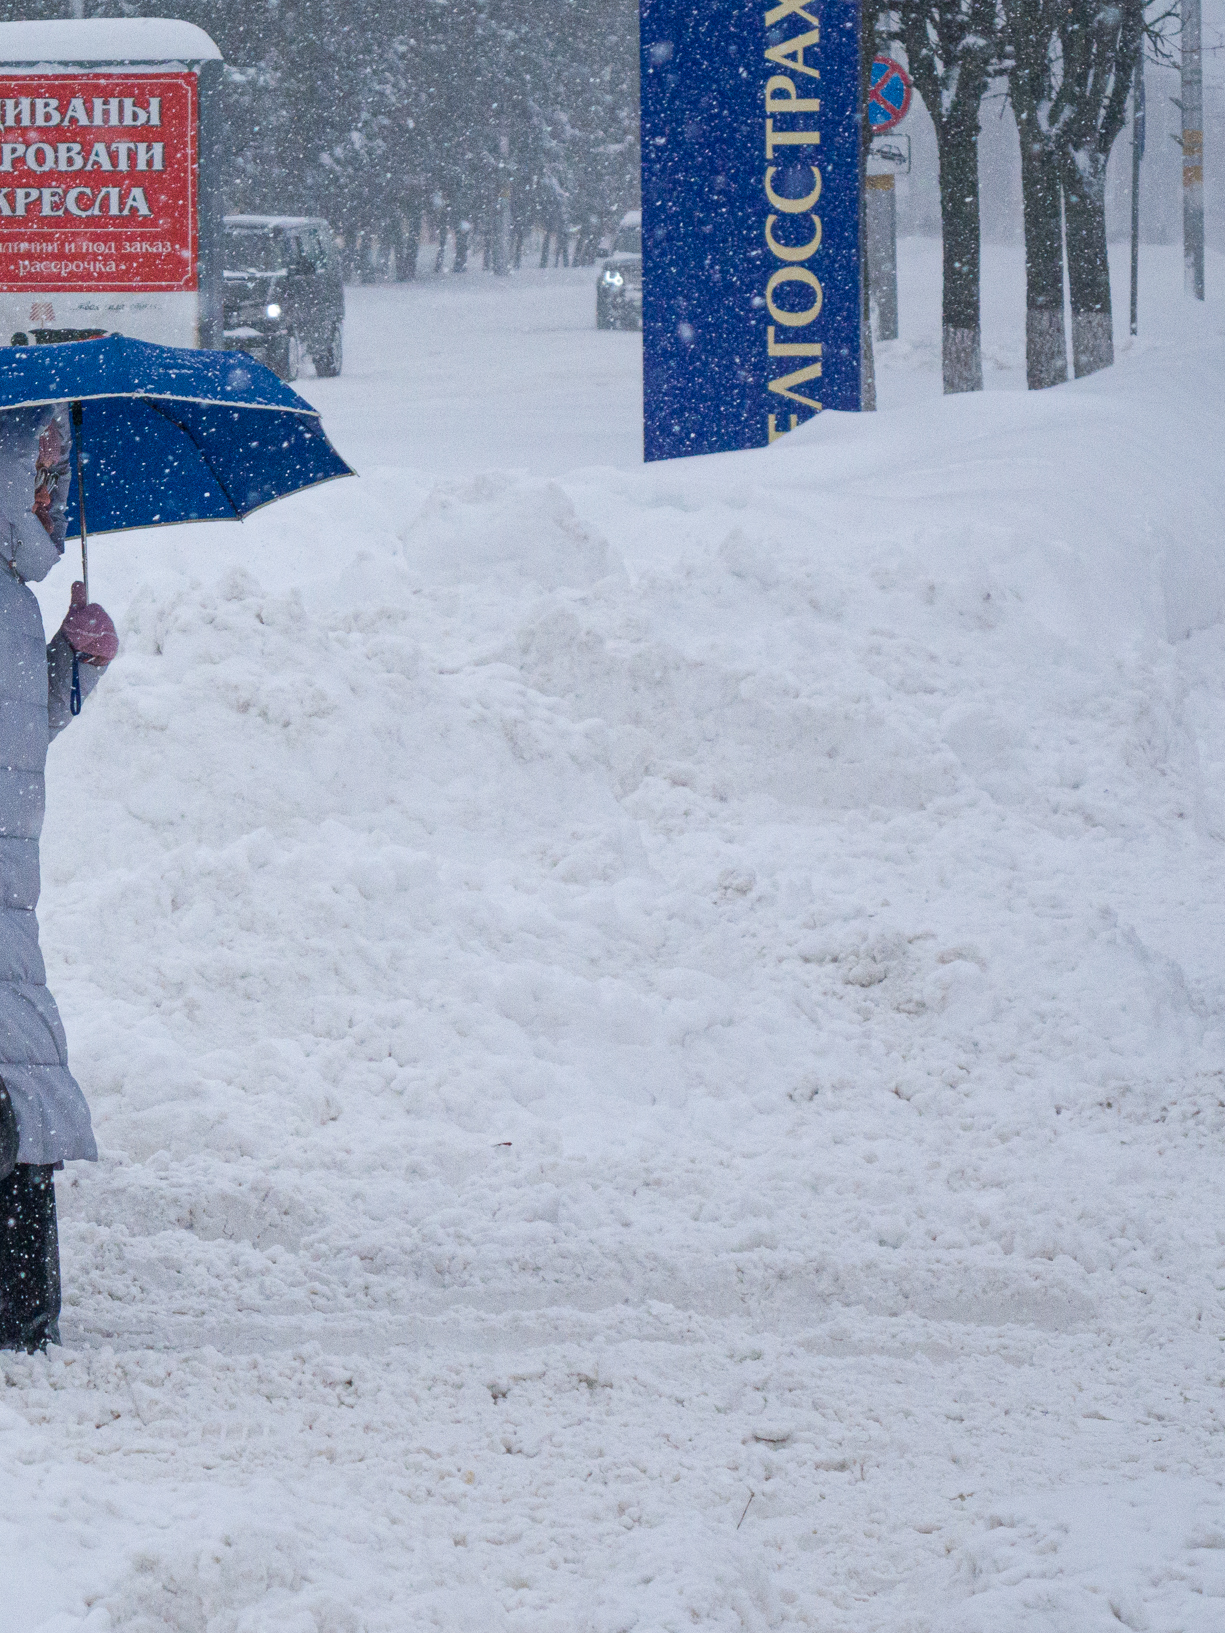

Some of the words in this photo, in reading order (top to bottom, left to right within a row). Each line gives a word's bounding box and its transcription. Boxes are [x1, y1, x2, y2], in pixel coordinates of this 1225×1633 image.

[65, 241, 75, 253] и
[82, 241, 116, 254] под
[122, 241, 172, 253] заказ
[19, 260, 116, 276] рассрочка
